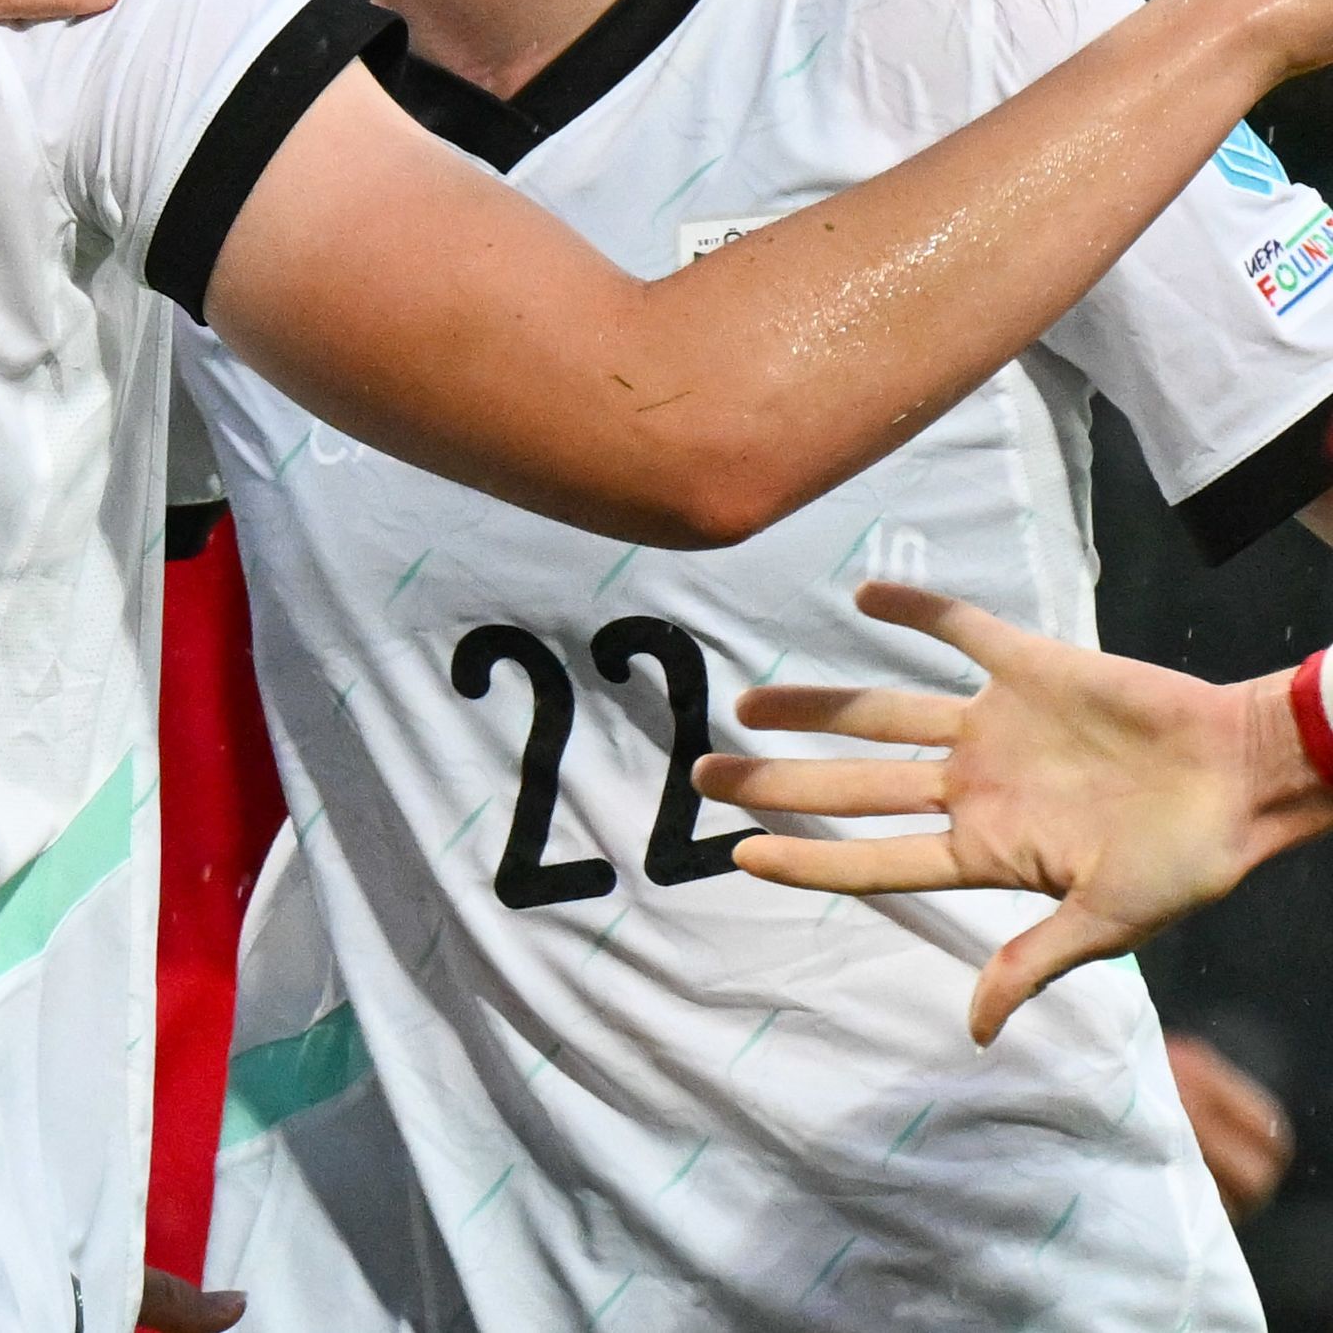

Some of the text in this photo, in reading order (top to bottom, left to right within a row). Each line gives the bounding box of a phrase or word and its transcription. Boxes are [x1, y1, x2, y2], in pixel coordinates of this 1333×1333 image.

[1244, 239, 1284, 278] UEFA
[1256, 217, 1333, 307] FOUND
[451, 615, 770, 910] 22
